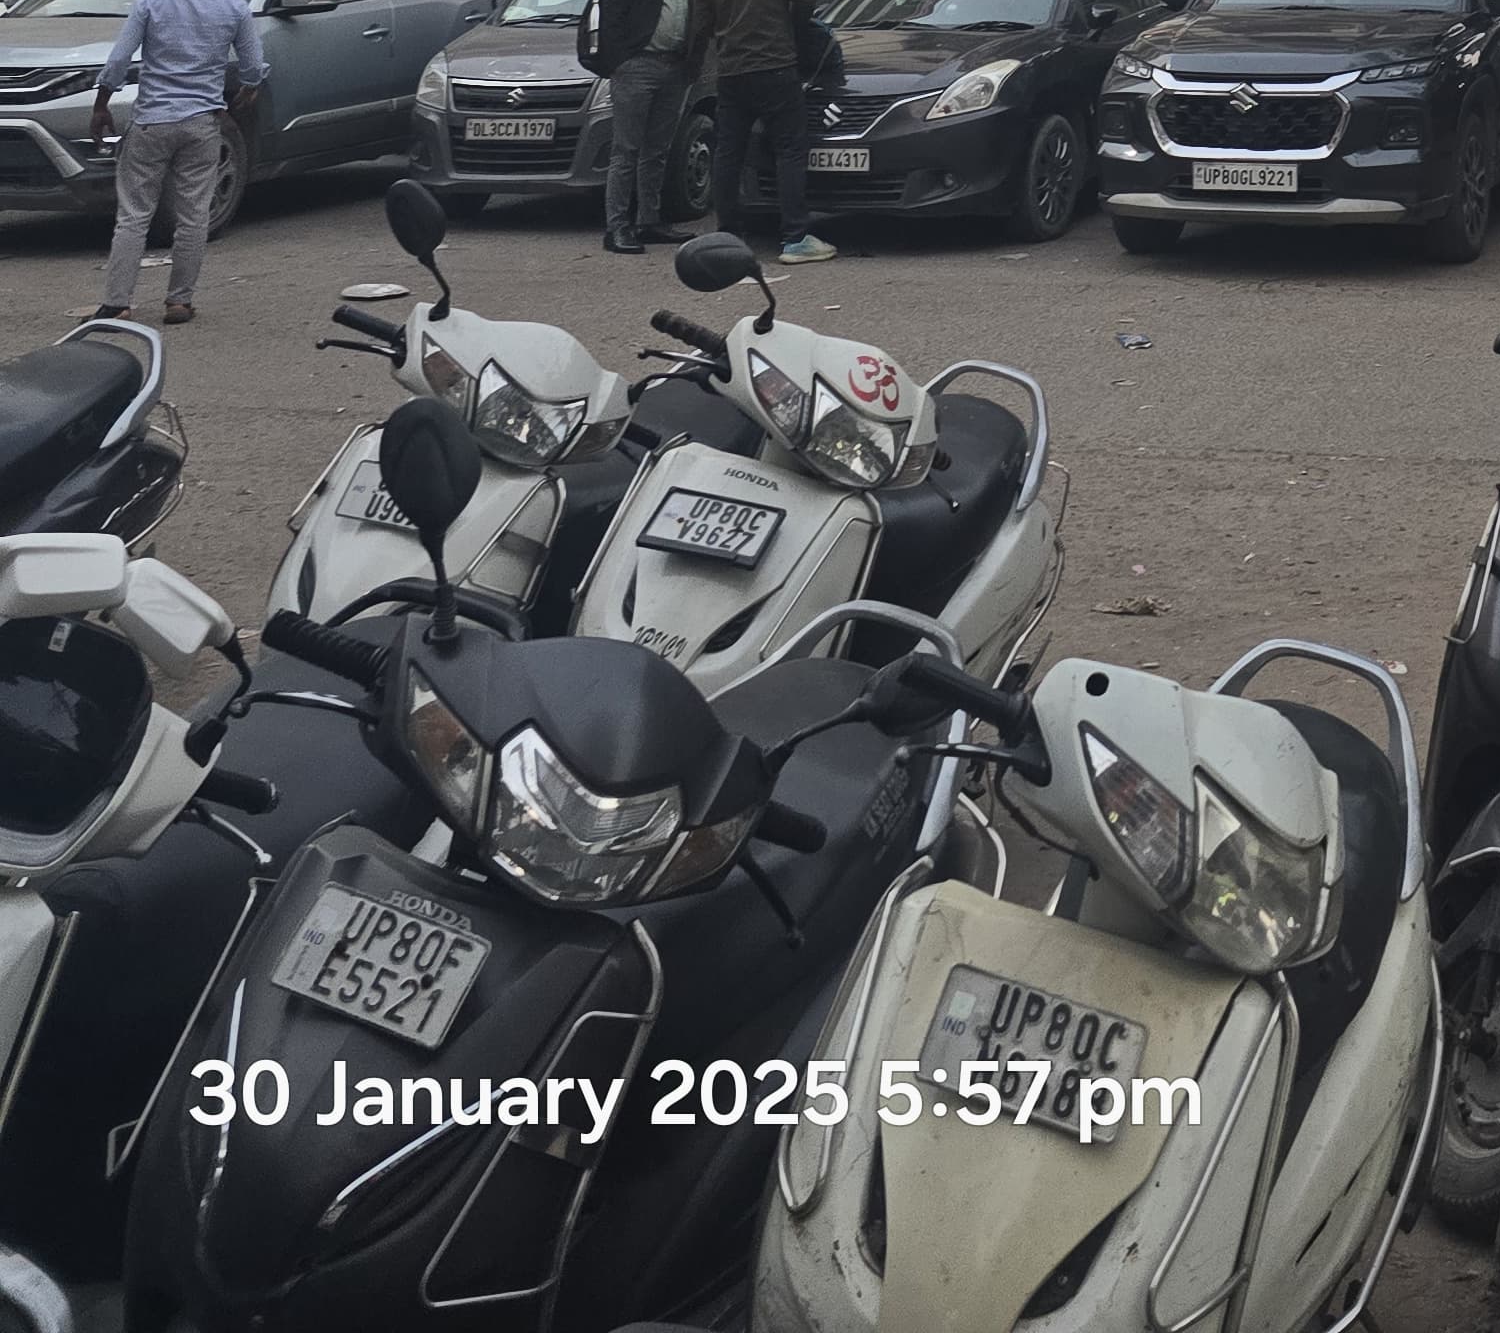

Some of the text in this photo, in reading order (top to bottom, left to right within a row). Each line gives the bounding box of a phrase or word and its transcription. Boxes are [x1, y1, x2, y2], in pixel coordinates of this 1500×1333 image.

[471, 119, 554, 139] DL3CCA1970
[1203, 166, 1294, 187] UP80GL9221
[723, 468, 780, 492] HONDA
[689, 497, 767, 532] UP80C
[677, 519, 756, 554] V9627
[387, 889, 473, 932] HONDA
[341, 900, 474, 983] UP80F
[310, 939, 445, 1034] E5521
[989, 983, 1128, 1072] UP80C
